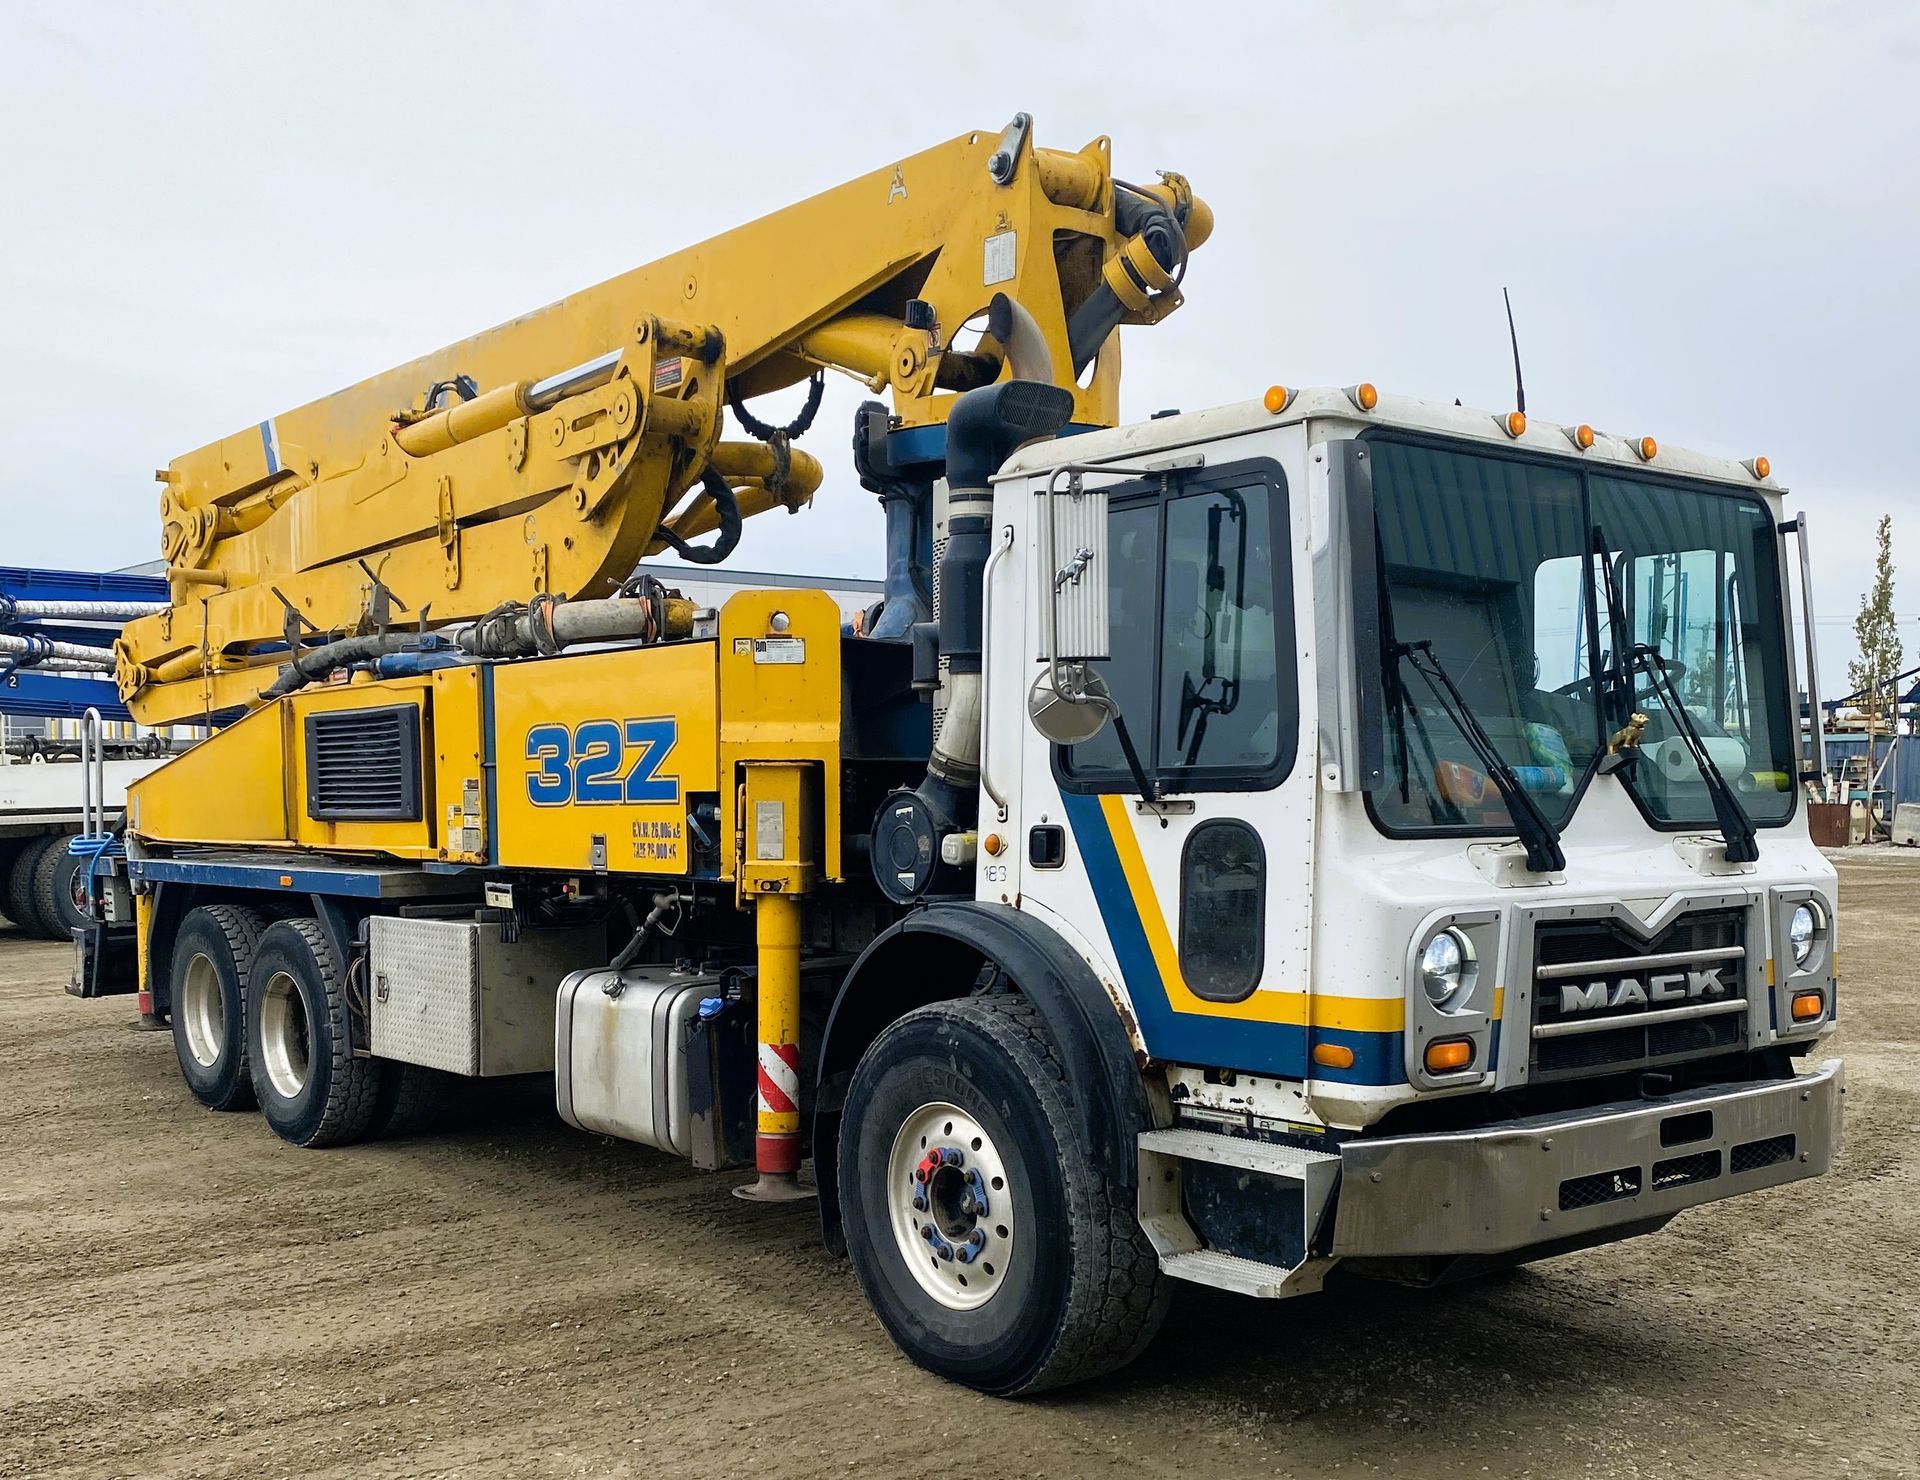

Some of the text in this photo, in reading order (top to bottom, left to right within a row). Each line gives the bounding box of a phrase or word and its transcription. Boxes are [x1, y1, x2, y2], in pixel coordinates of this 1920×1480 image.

[9, 675, 17, 687] 2
[525, 715, 680, 808] 32Z
[983, 865, 1007, 882] 183
[1559, 967, 1725, 1014] MACK
